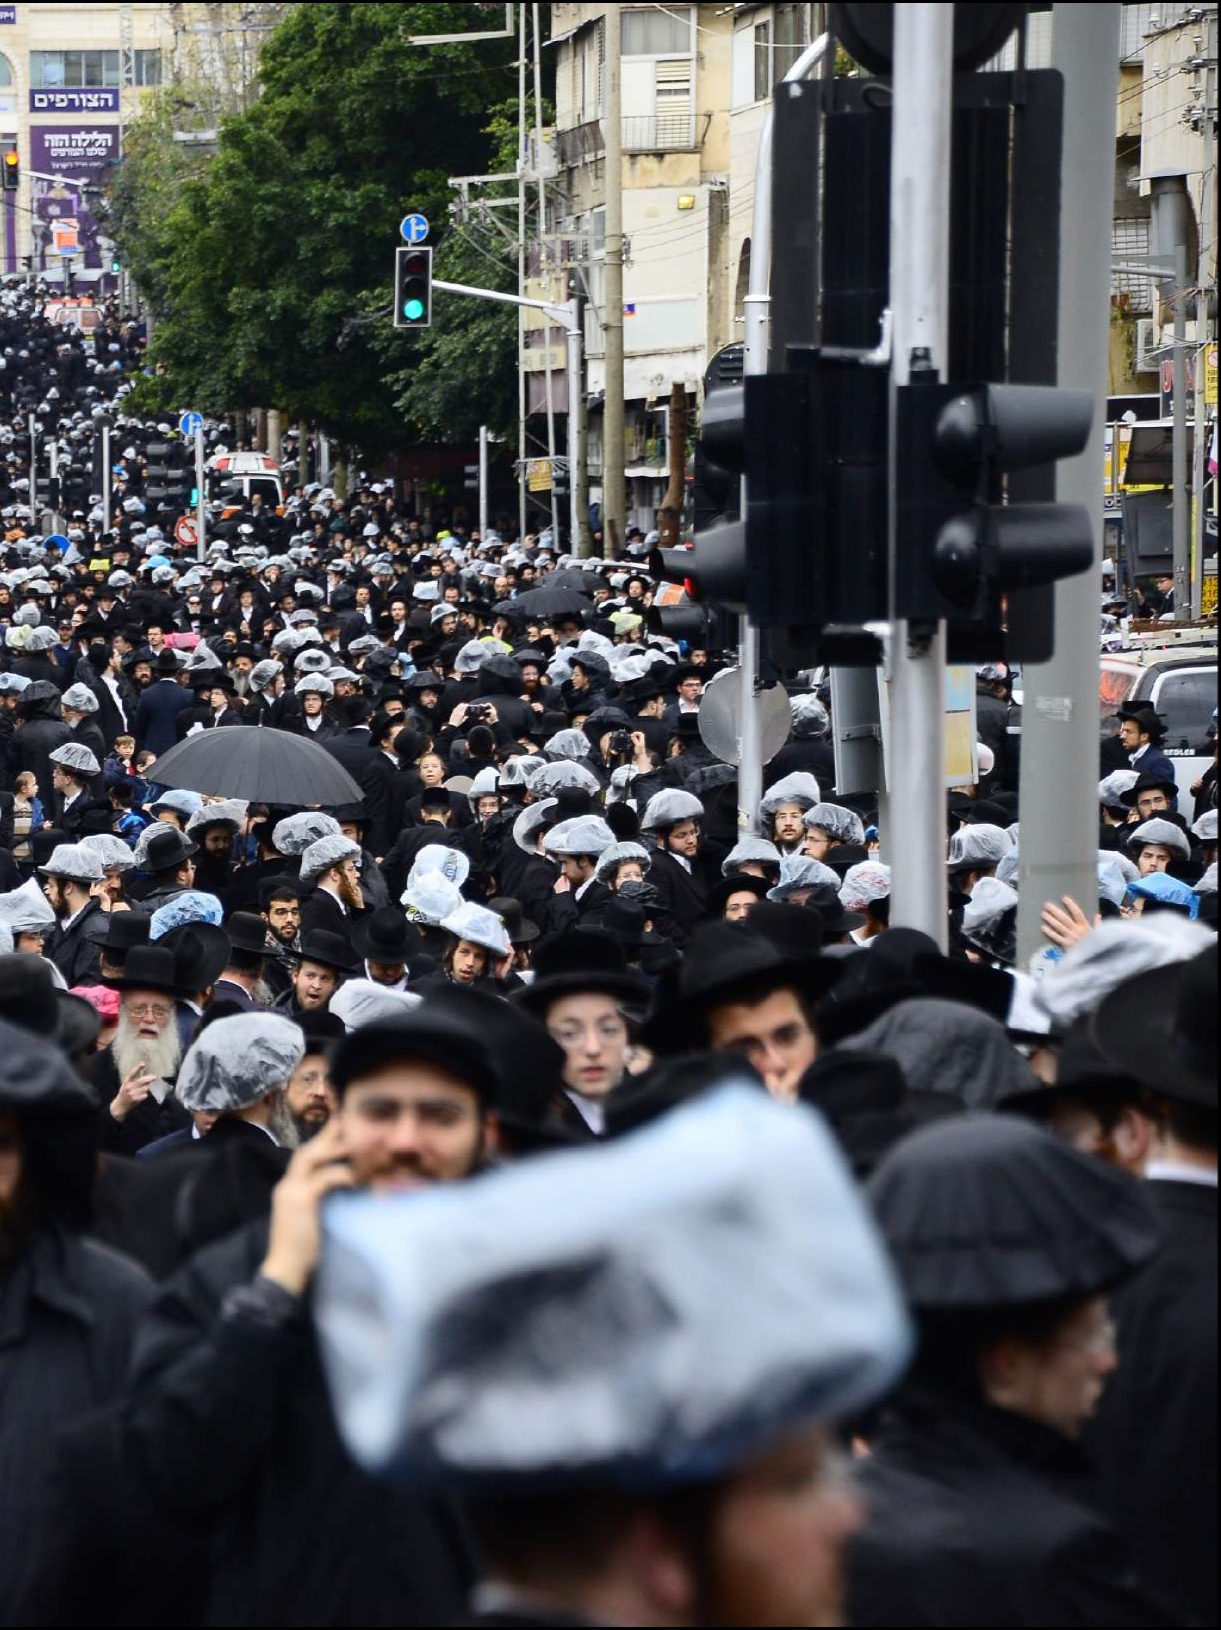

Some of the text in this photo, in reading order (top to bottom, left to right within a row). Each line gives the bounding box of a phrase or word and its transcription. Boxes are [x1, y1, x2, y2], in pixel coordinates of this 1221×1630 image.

[34, 93, 113, 108] הצורפים
[44, 131, 113, 147] הלילה הזה
